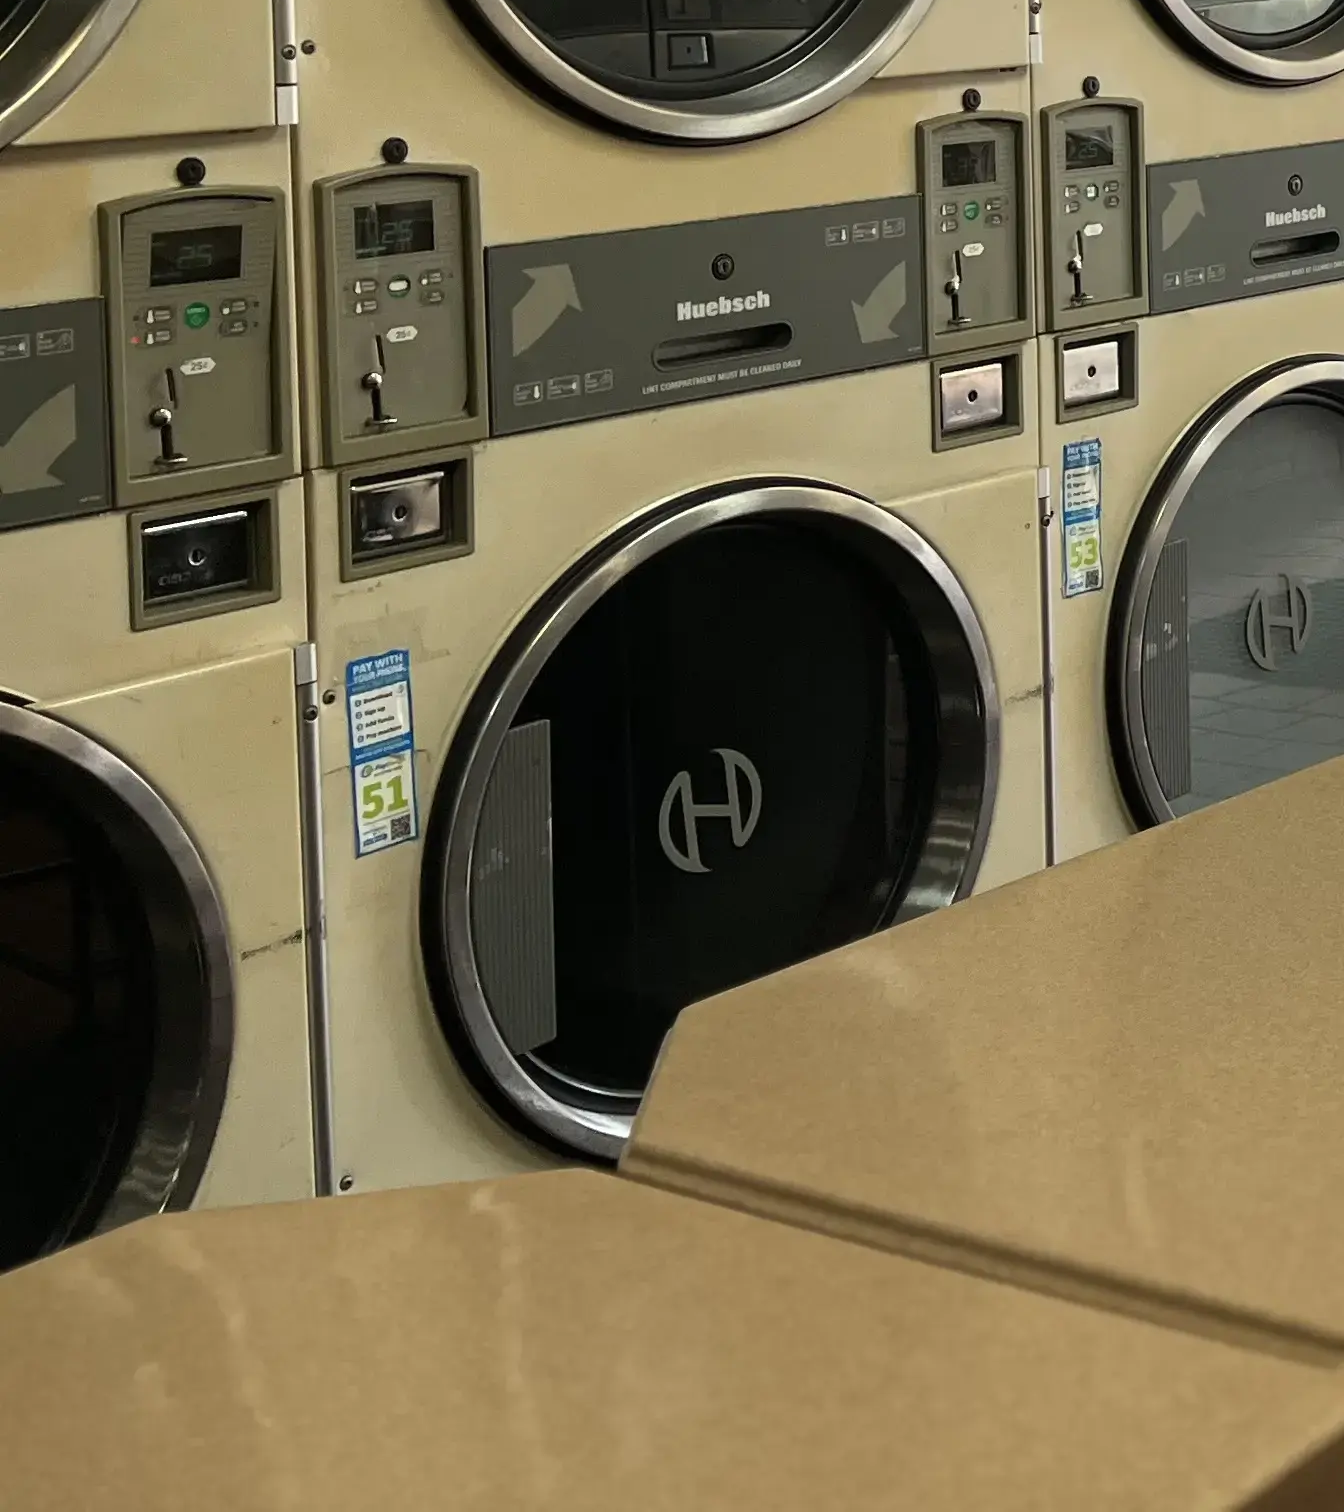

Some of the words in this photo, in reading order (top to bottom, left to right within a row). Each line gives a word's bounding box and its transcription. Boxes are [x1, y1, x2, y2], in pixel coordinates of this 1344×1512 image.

[1265, 203, 1326, 227] Huebsch
[677, 290, 770, 321] Huebsch
[1070, 537, 1098, 569] 53
[352, 662, 373, 675] PAY
[374, 653, 403, 668] WITH
[362, 775, 408, 820] 51
